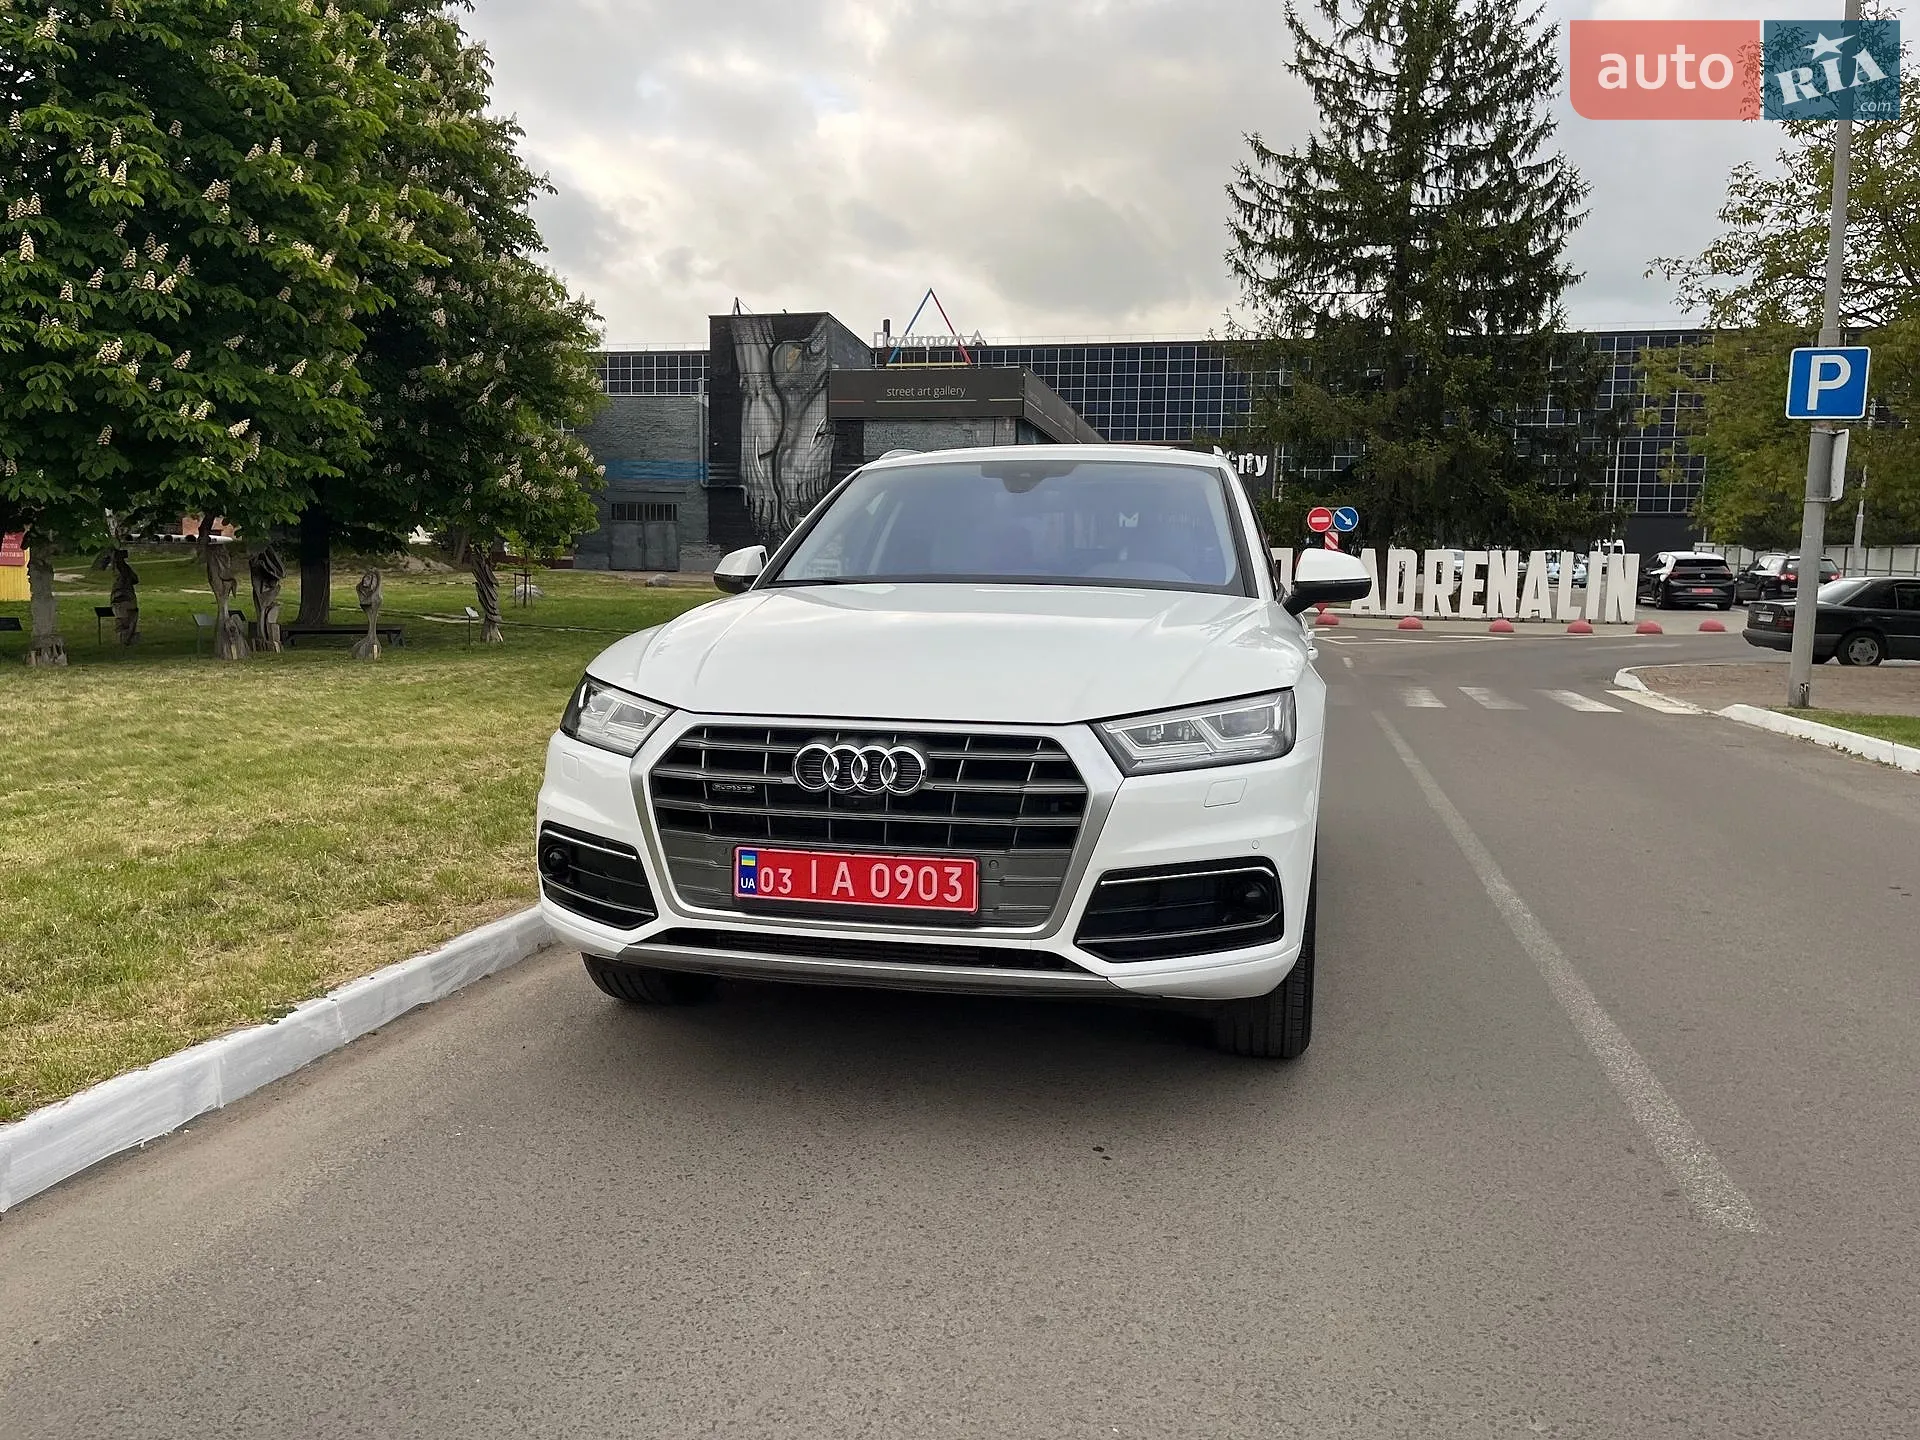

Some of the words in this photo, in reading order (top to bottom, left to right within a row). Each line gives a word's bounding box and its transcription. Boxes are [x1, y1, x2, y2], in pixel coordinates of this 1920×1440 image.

[886, 387, 915, 397] street
[917, 387, 931, 396] art
[933, 385, 966, 398] gallery
[1806, 354, 1852, 411] P
[1350, 548, 1640, 622] ADRENALIN
[740, 877, 756, 889] UA
[760, 866, 793, 895] 03
[870, 863, 963, 903] 0903
